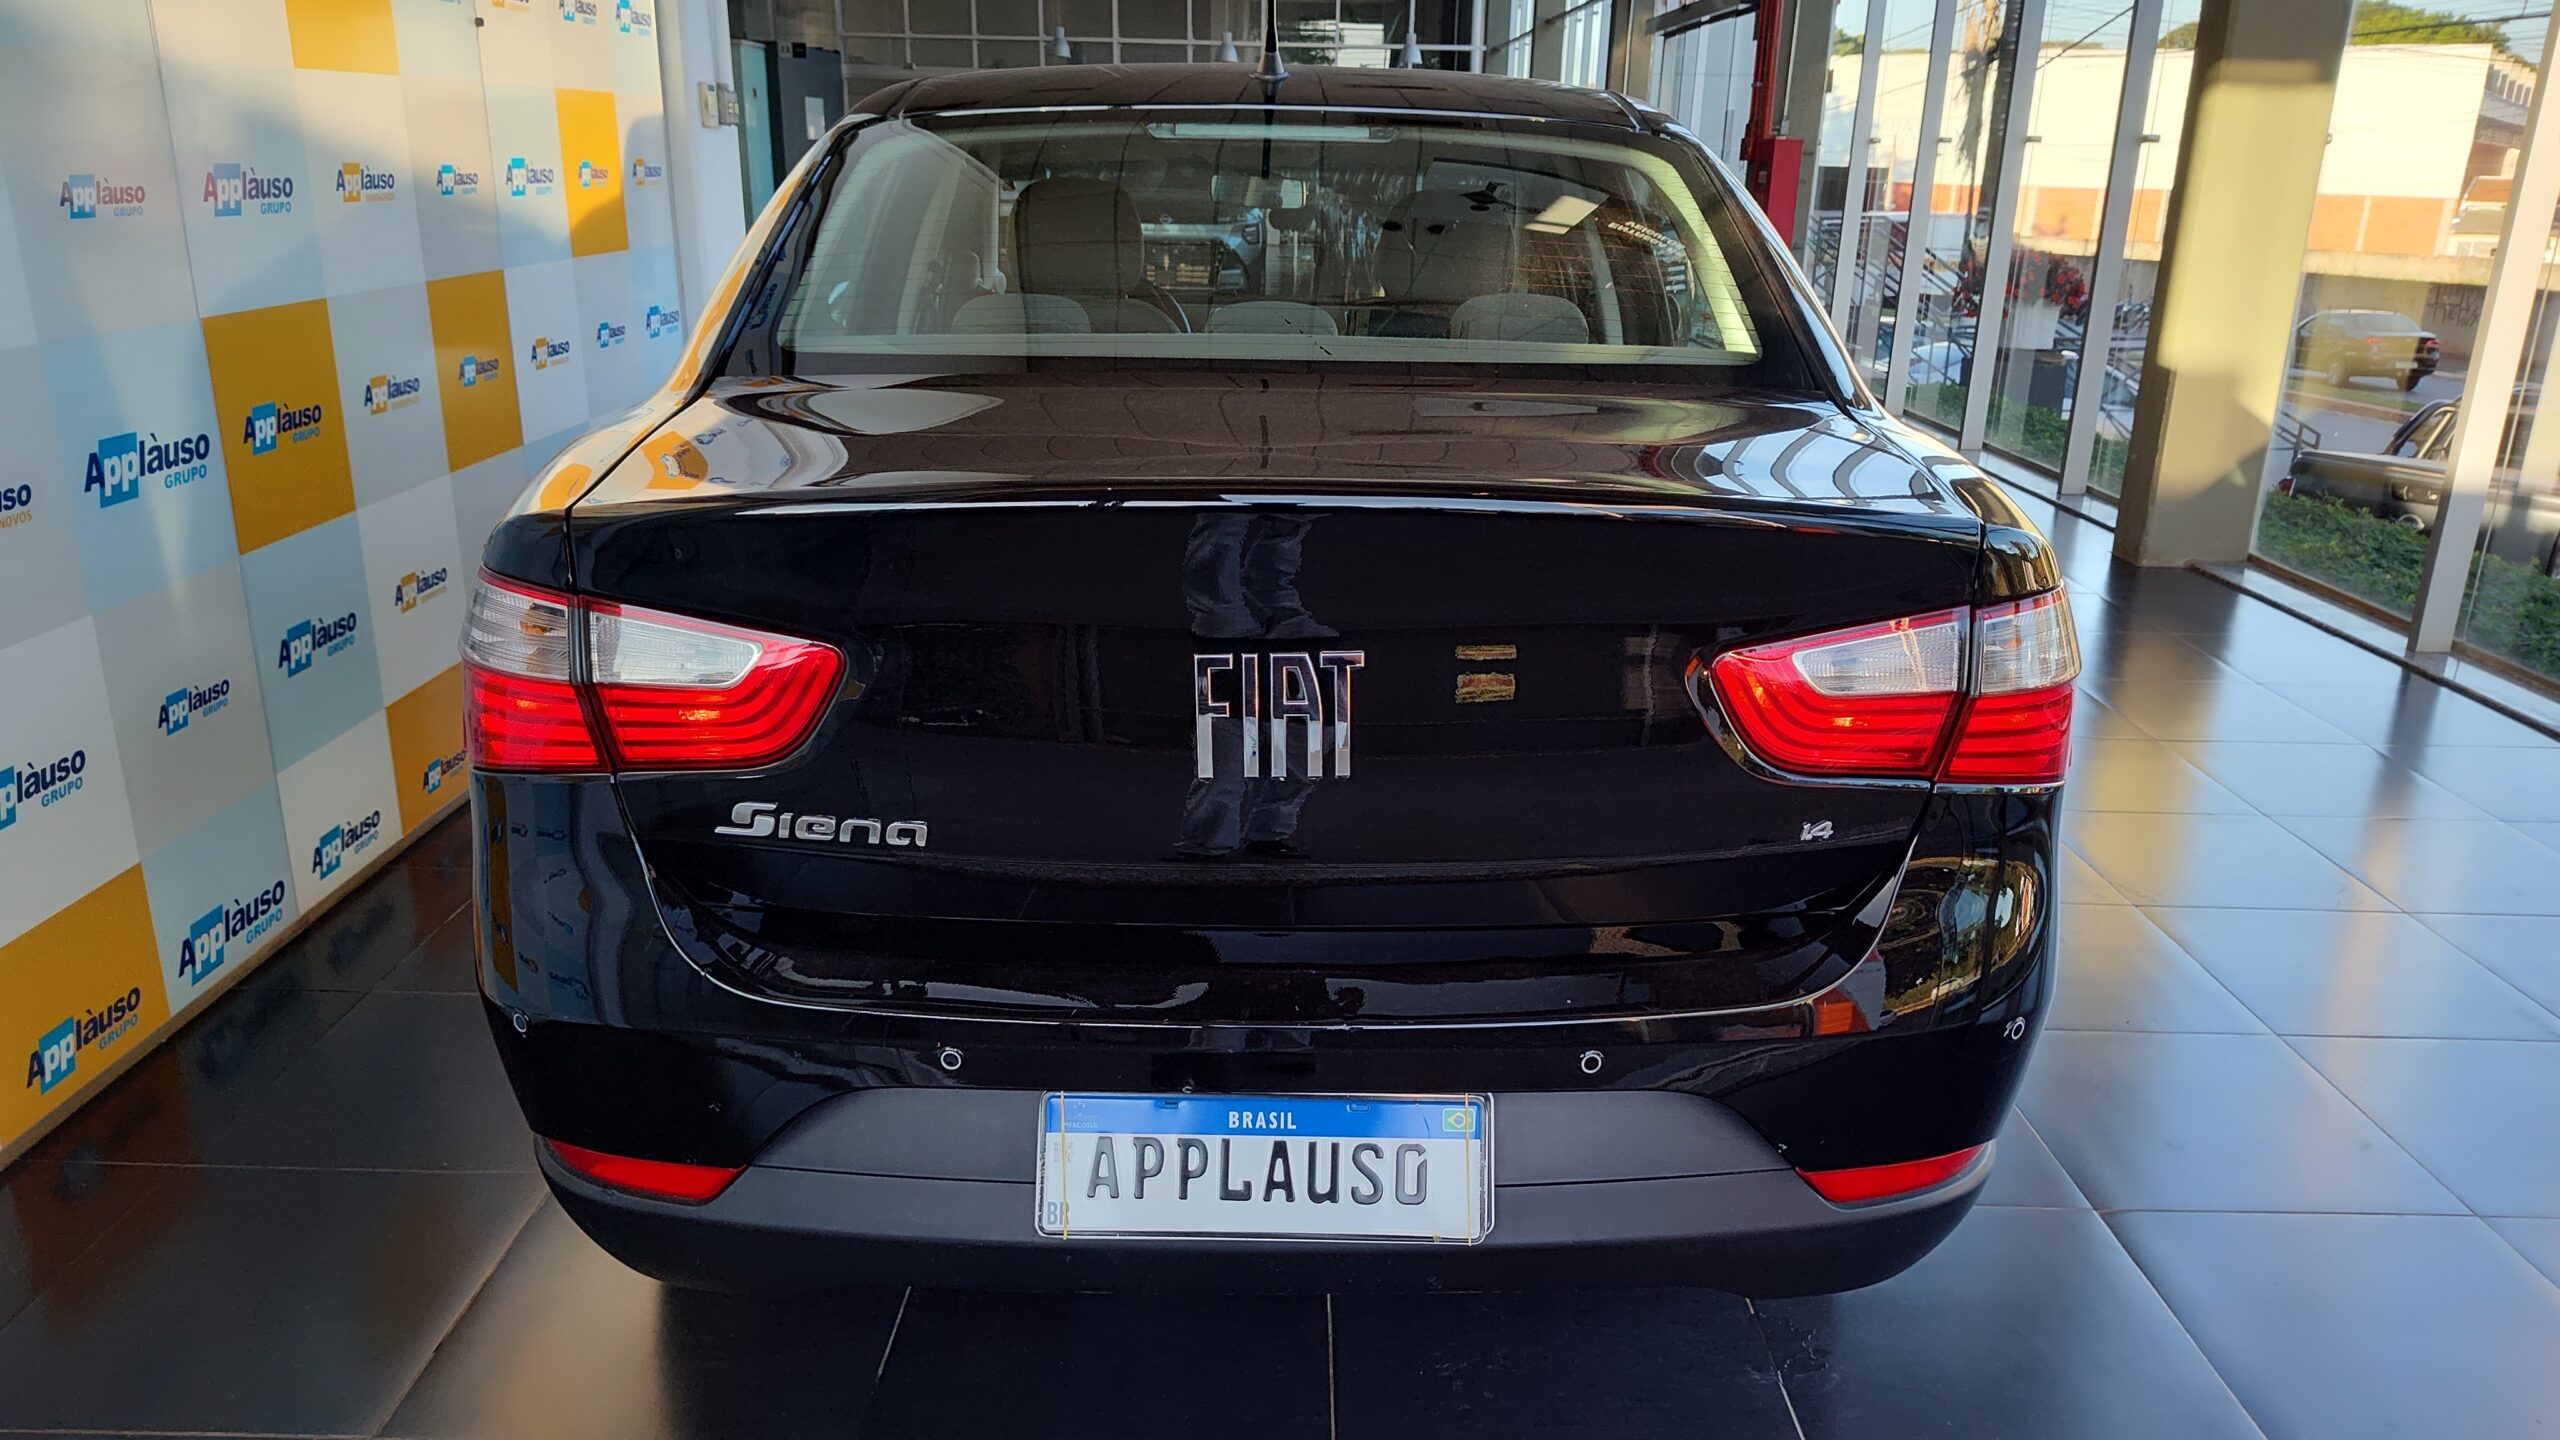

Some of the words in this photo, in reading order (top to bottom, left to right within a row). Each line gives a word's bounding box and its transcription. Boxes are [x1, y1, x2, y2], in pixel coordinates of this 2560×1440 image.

[60, 177, 145, 212] Applàuso
[113, 206, 143, 216] GRUPO
[203, 167, 293, 210] Applàuso
[260, 201, 291, 214] GRUPO
[243, 403, 322, 448] Applàuso
[84, 433, 210, 498] Applàuso
[164, 464, 207, 489] GRUPO
[278, 612, 357, 669] Applàuso
[158, 679, 230, 729] Applàuso
[1194, 650, 1365, 779] FIAT
[41, 777, 83, 807] GRUPO
[312, 810, 380, 874] Applàuso
[714, 801, 928, 847] Siena
[178, 880, 286, 978] Applàuso
[246, 907, 283, 944] GRUPO
[26, 987, 141, 1089] Applàuso
[99, 1013, 138, 1051] GRUPO
[1228, 1110, 1297, 1130] BRASIL
[1086, 1136, 1428, 1206] APPLAUSO
